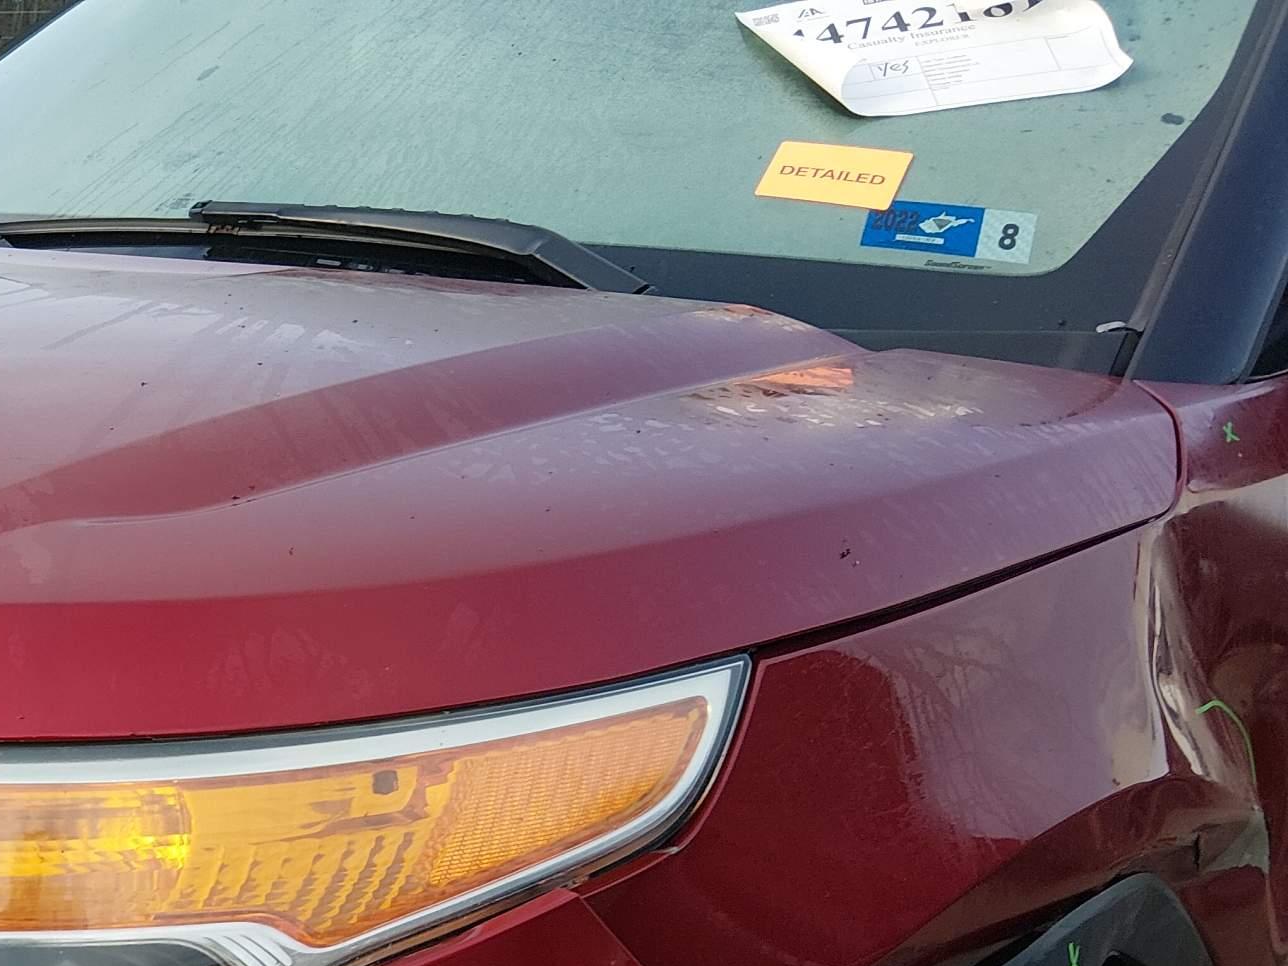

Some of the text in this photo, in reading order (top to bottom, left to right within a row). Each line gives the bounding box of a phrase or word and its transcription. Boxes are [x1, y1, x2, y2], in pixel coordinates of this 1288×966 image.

[847, 24, 977, 50] Casualty Insurance
[779, 164, 886, 186] DETAILED
[871, 209, 920, 234] 2022
[998, 223, 1020, 251] 8
